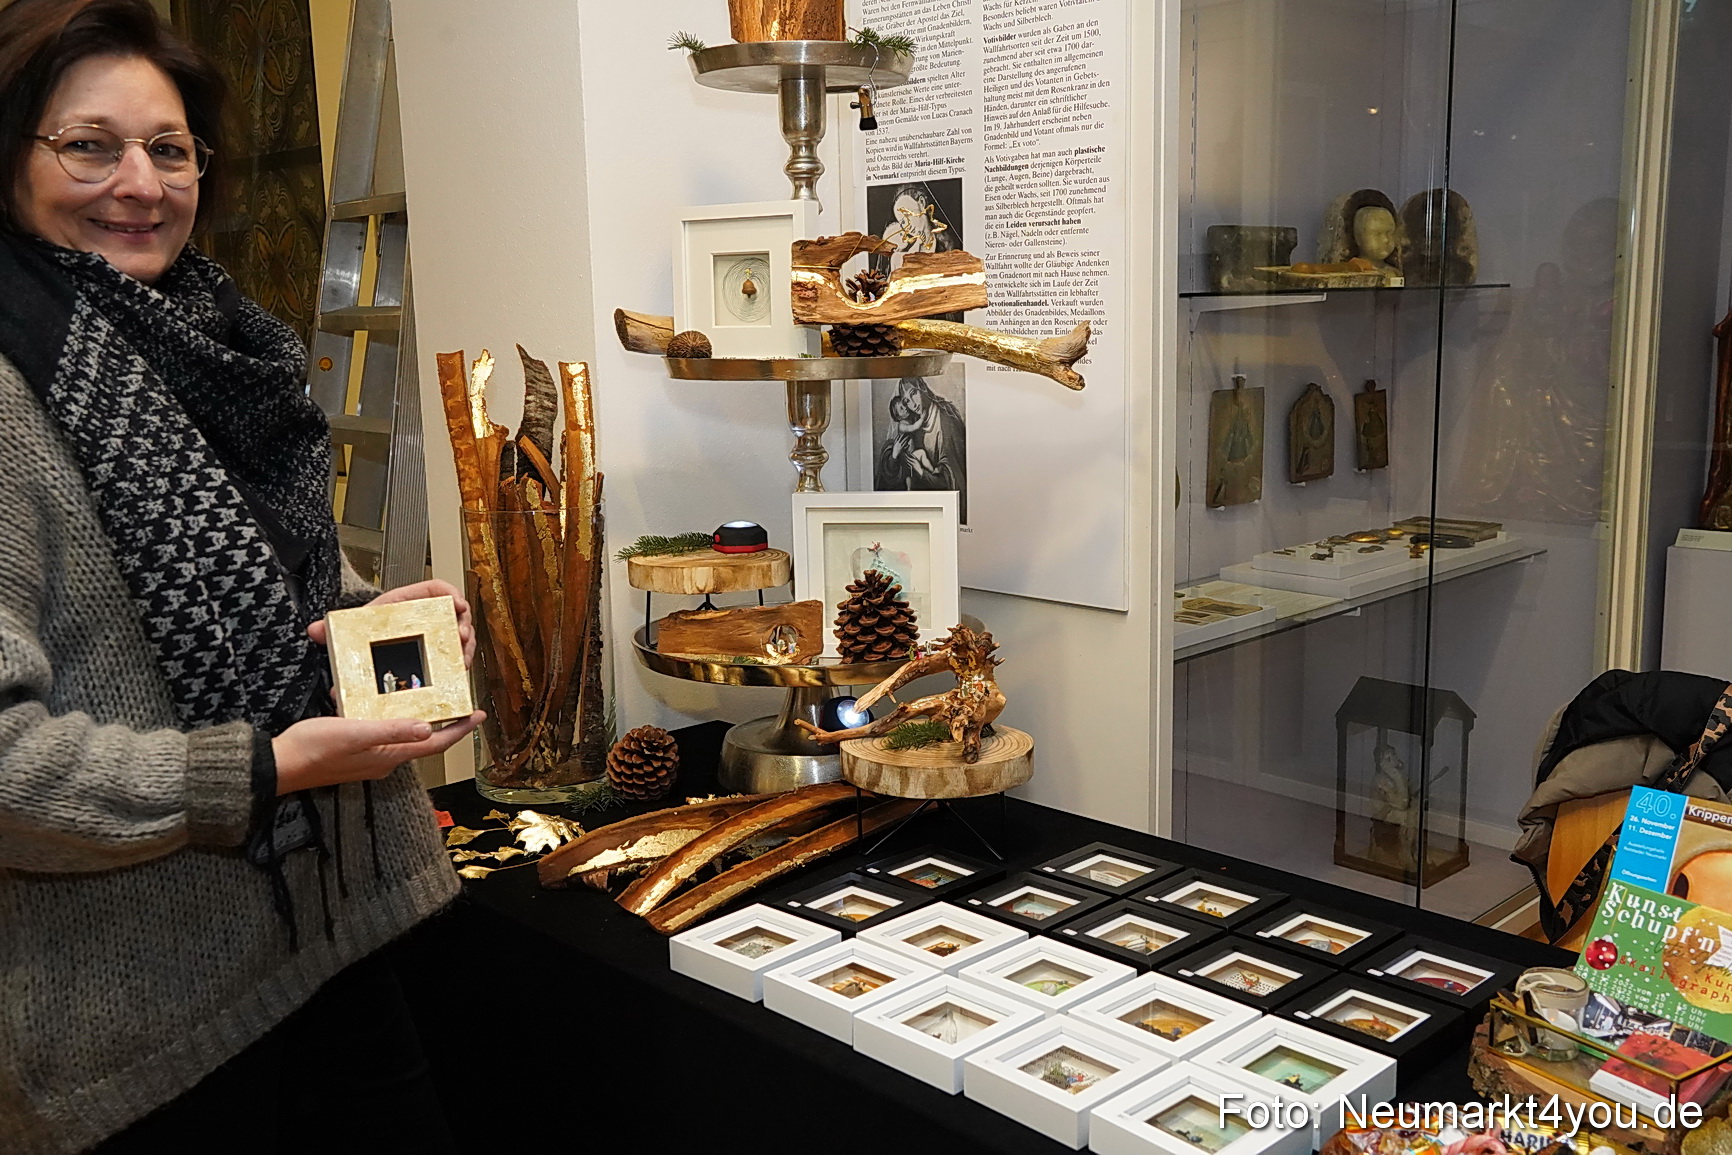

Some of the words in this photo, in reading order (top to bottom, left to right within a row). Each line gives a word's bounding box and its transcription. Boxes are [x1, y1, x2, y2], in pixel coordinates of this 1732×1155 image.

[863, 7, 879, 15] Waren
[863, 11, 912, 25] Erinnerungsstätten
[933, 1, 950, 11] Leben
[983, 3, 1002, 11] Wachs
[983, 10, 1014, 21] Besonders
[1016, 6, 1036, 16] beliebt
[886, 20, 904, 29] Gräber
[917, 14, 938, 25] Apostel
[1017, 13, 1053, 25] Silberblech.
[903, 28, 915, 36] Orte
[928, 19, 972, 32] Gnadenbildern,
[984, 33, 1016, 44] Votivbilder
[1018, 29, 1041, 38] wurden
[1053, 23, 1074, 32] Gaben
[915, 30, 955, 42] Wirkungskraft
[939, 37, 973, 48] Mittelpunkt.
[942, 50, 964, 58] Marien-
[983, 42, 1029, 54] Wallfahrtsorten
[983, 52, 1017, 64] zunehmend
[1064, 43, 1079, 51] 1700
[930, 60, 961, 70] Bedeutung.
[983, 64, 1010, 76] gebracht.
[1024, 57, 1052, 68] enthalten
[1064, 50, 1103, 62] allgemeinen
[927, 72, 949, 82] spielten
[998, 70, 1032, 82] Darstellung
[1047, 62, 1086, 74] angerufenen
[984, 84, 1008, 93] Heiligen
[1036, 76, 1063, 85] Votanten
[1074, 72, 1099, 80] Gebets-
[878, 89, 912, 98] künstlerische
[914, 85, 929, 93] Werte
[892, 97, 908, 106] Rolle.
[936, 90, 972, 100] verbreitesten
[984, 94, 1005, 103] haltung
[1051, 84, 1088, 94] Rosenkranz
[900, 102, 947, 114] Maria-Hilf-Typus
[984, 104, 1009, 112] Händen,
[1010, 100, 1036, 109] darunter
[1050, 93, 1087, 104] schriftlicher
[895, 114, 919, 124] Gemälde
[932, 110, 948, 119] Lucas
[949, 108, 972, 117] Cranach
[984, 114, 1008, 122] Hinweis
[1074, 101, 1110, 111] Hilfesuche.
[1004, 119, 1040, 129] Jahrhundert
[1042, 115, 1070, 125] erscheint
[1072, 113, 1092, 121] neben
[877, 127, 889, 135] 1537.
[899, 131, 945, 141] unüberschaubare
[947, 128, 959, 136] Zahl
[984, 131, 1018, 141] Gnadenbild
[1034, 127, 1054, 135] Votant
[1056, 123, 1079, 132] oftmals
[866, 147, 884, 155] Kopien
[904, 139, 949, 151] Wallfahrtsstätten
[950, 137, 973, 146] Bayerns
[984, 142, 1007, 151] Formel:
[877, 153, 907, 162] Österreichs
[996, 153, 1029, 163] Votivgaben
[1074, 145, 1105, 157] plastische
[914, 156, 964, 167] Maria-Hilf-Kirche
[984, 163, 1029, 173] Nachbildungen
[1030, 160, 1063, 170] derjenigen
[1065, 156, 1102, 166] Körperteile
[873, 172, 899, 180] Neumarkt
[928, 168, 947, 176] diesem
[948, 166, 966, 174] Typus.
[984, 175, 1007, 184] (Lunge,
[1032, 170, 1053, 179] Beine)
[995, 182, 1014, 193] geheilt
[1016, 181, 1037, 189] werden
[1017, 191, 1038, 199] Wachs,
[1053, 188, 1067, 196] 1700
[1069, 186, 1106, 195] zunehmend
[996, 200, 1029, 210] Silberblech
[1031, 198, 1064, 208] hergestellt.
[1025, 209, 1065, 218] Gegenstände
[1006, 220, 1026, 228] Leiden
[1029, 218, 1060, 226] verursacht
[1001, 229, 1019, 238] Nägel,
[1060, 227, 1089, 235] entfernte
[1024, 238, 1067, 246] Gallensteine).
[998, 251, 1032, 260] Erinnerung
[985, 262, 1012, 270] Wallfahrt
[1046, 260, 1074, 269] Gläubige
[994, 280, 1028, 288] entwickelte
[1000, 319, 1030, 327] Anhängen
[1635, 791, 1677, 820] 40.
[1642, 818, 1675, 830] November
[1639, 827, 1672, 839] Dezember
[1607, 882, 1683, 923] Kunst
[1601, 900, 1715, 952] Schupf'n
[1635, 993, 1650, 1002] von
[1689, 1015, 1706, 1024] Uhr
[1637, 987, 1652, 996] von
[1691, 1007, 1707, 1017] Uhr
[1633, 1000, 1648, 1009] von
[1688, 1022, 1704, 1031] Uhr
